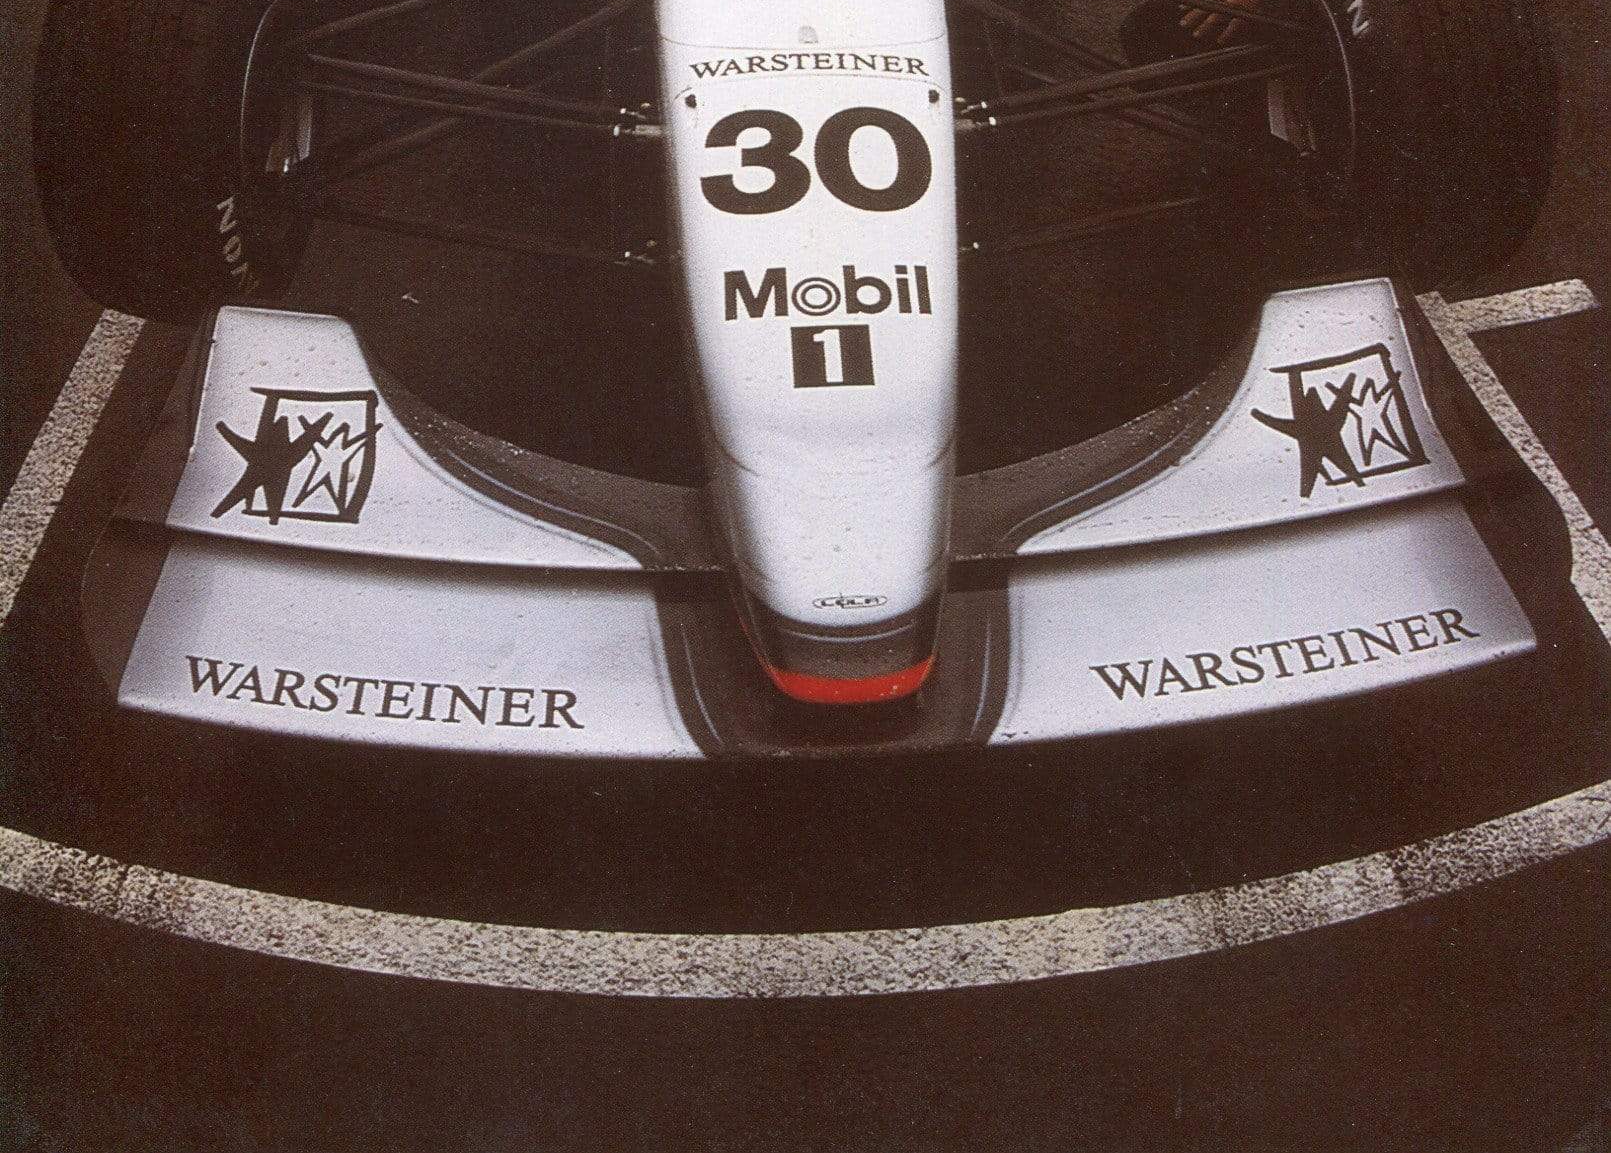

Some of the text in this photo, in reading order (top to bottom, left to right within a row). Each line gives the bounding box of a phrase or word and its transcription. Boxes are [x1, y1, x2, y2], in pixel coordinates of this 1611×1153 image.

[690, 53, 930, 79] WARSTEINER
[700, 106, 932, 215] 30
[723, 264, 932, 321] Mobil
[185, 654, 584, 730] WARSTEINER
[1088, 608, 1480, 701] WARSTEINER
